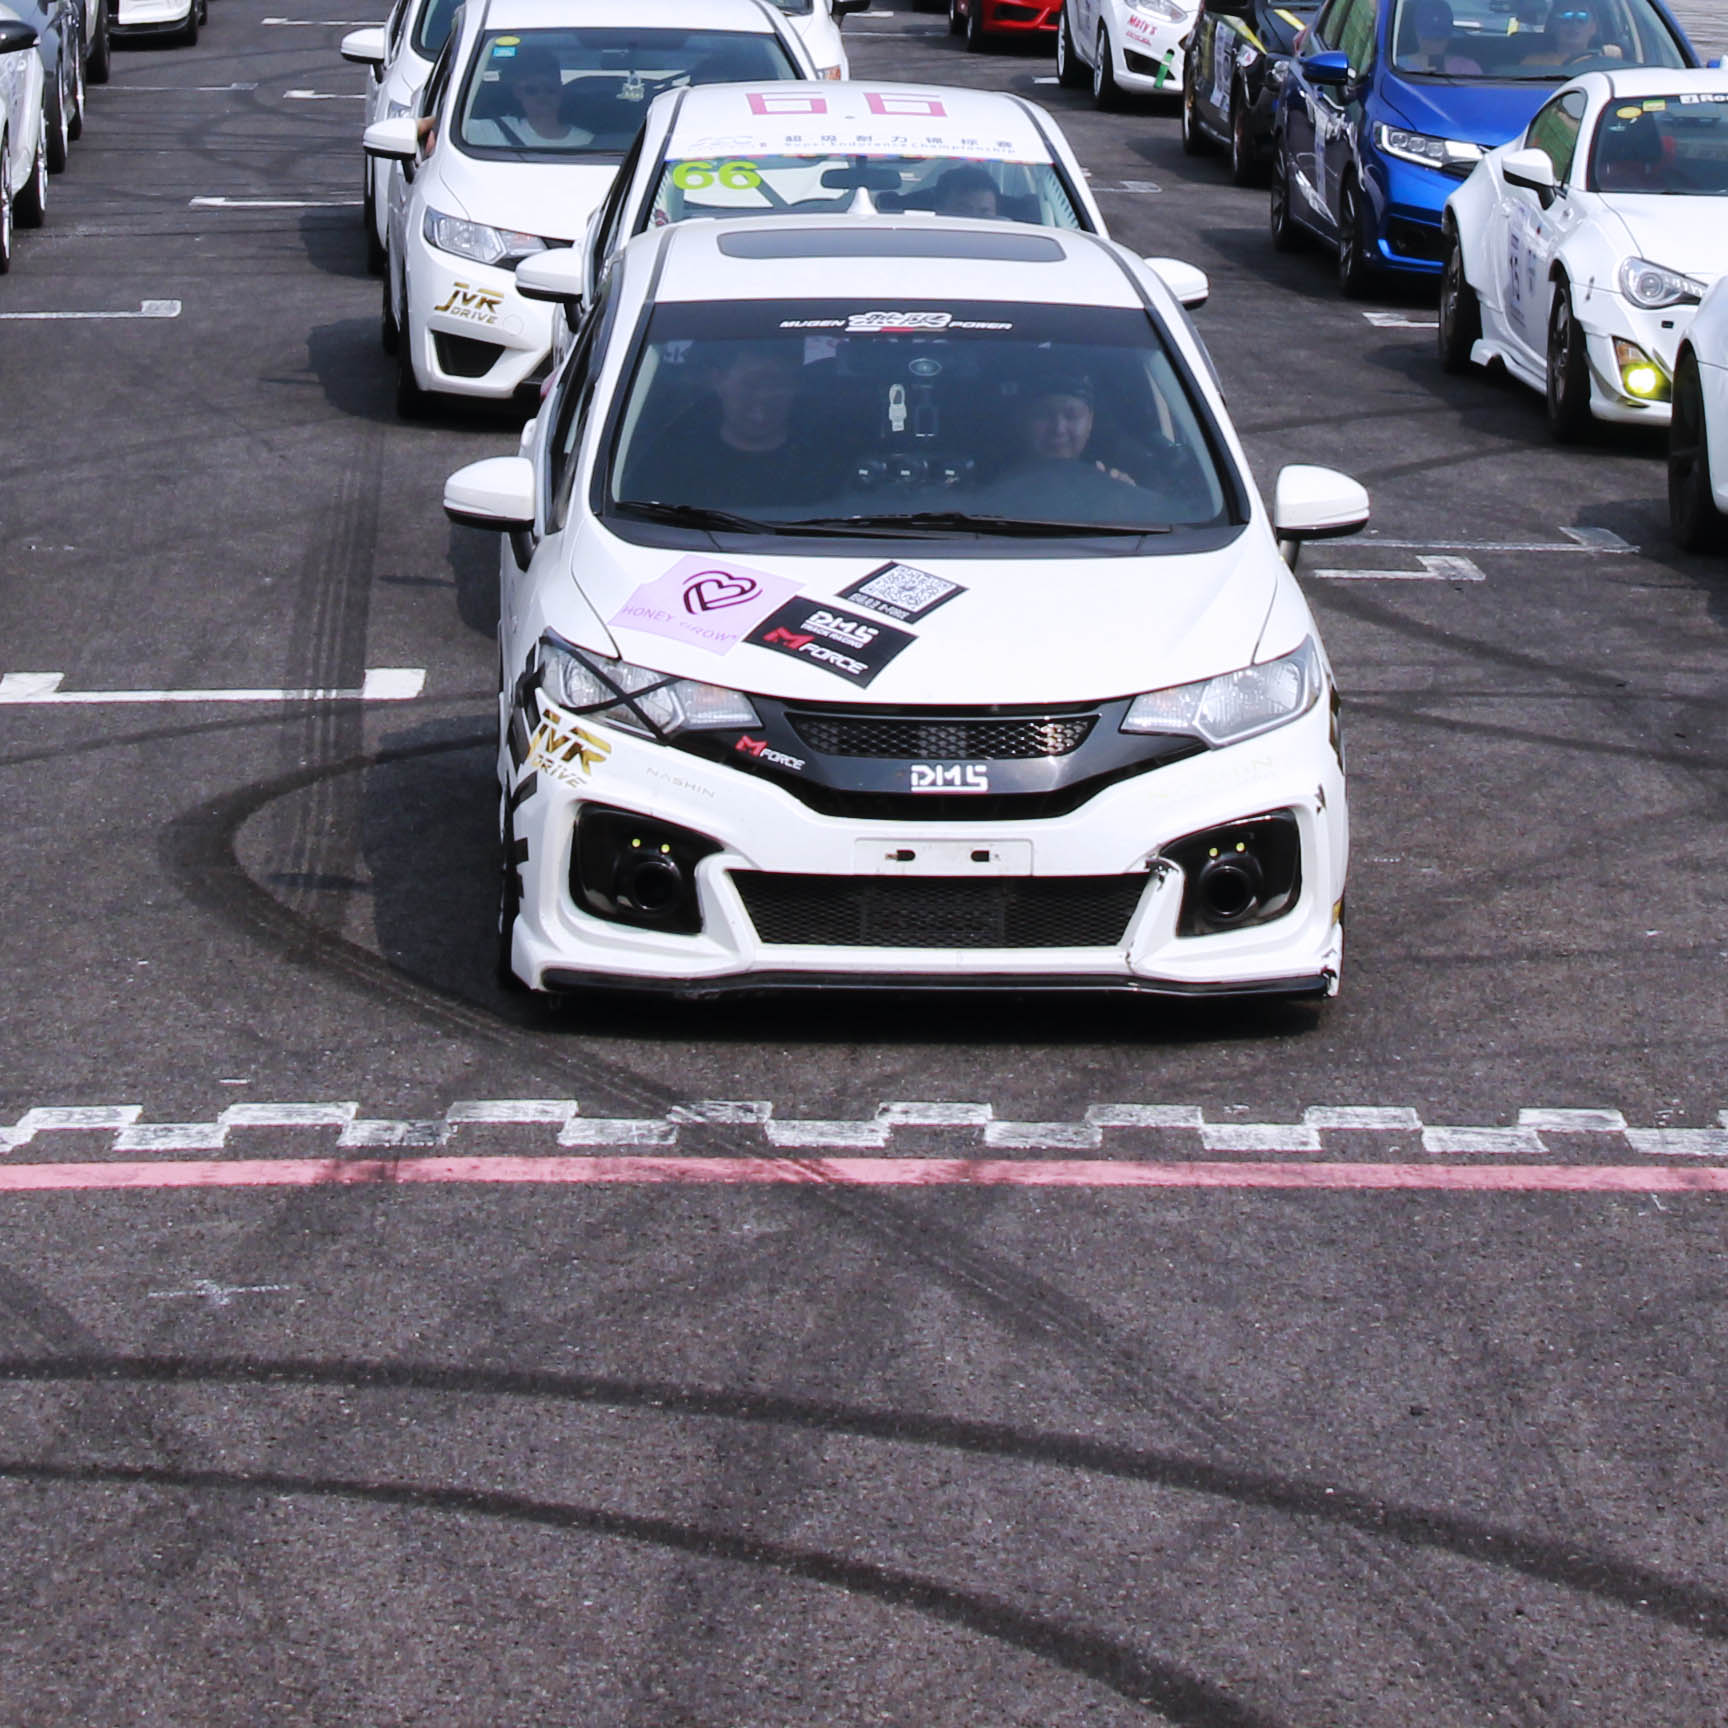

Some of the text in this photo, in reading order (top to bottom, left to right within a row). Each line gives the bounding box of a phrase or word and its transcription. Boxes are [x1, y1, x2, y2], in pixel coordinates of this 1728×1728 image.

[672, 161, 761, 190] 66
[450, 306, 499, 324] DRIVE
[778, 319, 1014, 330] MUGEN POWER
[621, 604, 676, 623] HONEY
[530, 753, 587, 789] DRIVE
[645, 767, 717, 799] NASHIN
